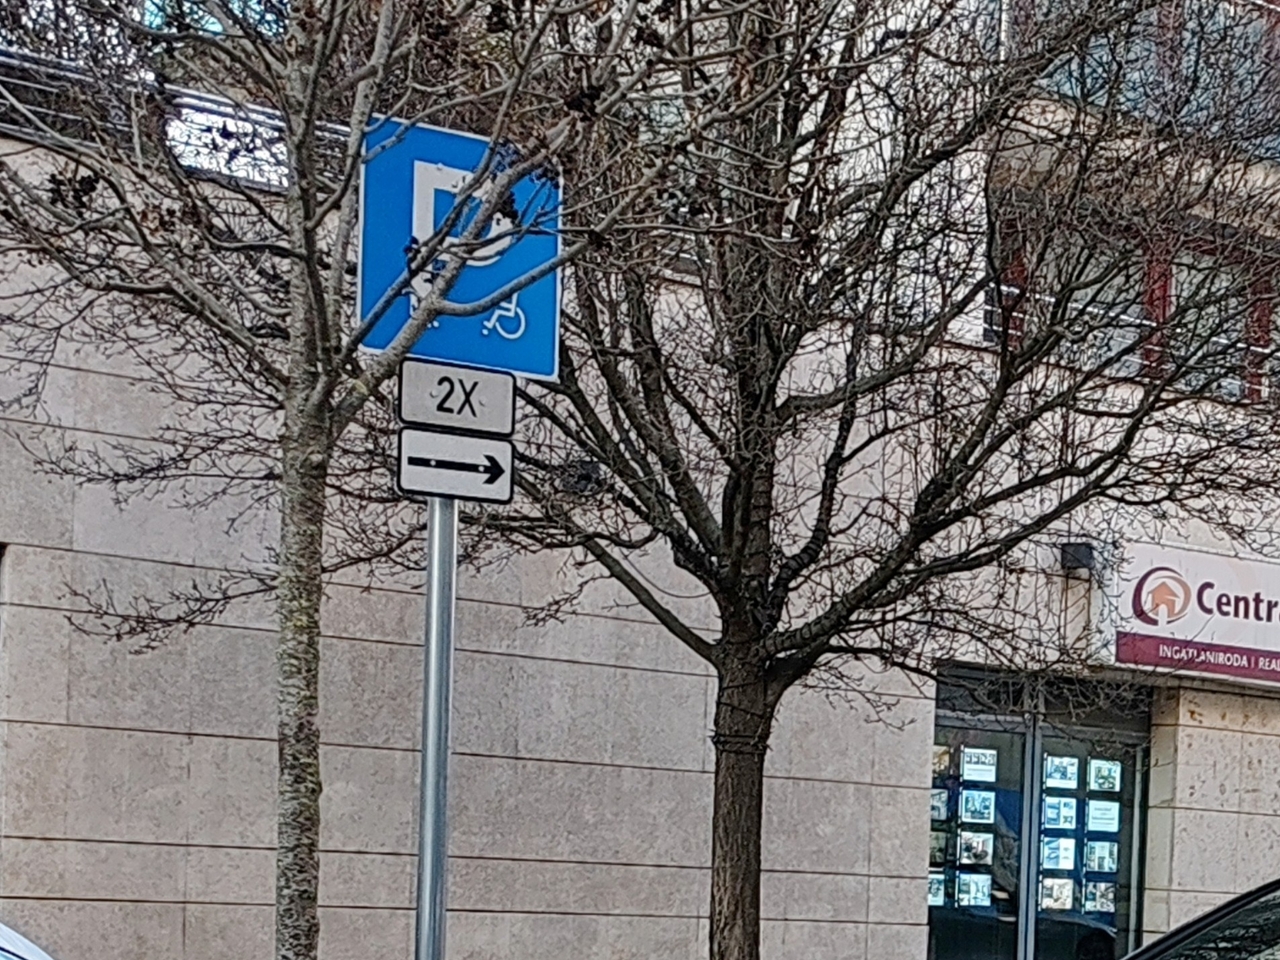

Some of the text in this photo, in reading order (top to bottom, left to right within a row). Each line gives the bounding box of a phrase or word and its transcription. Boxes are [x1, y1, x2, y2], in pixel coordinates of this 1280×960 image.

[410, 160, 516, 318] P
[435, 375, 480, 418] 2X
[1158, 644, 1249, 668] INGATLANIRODA
